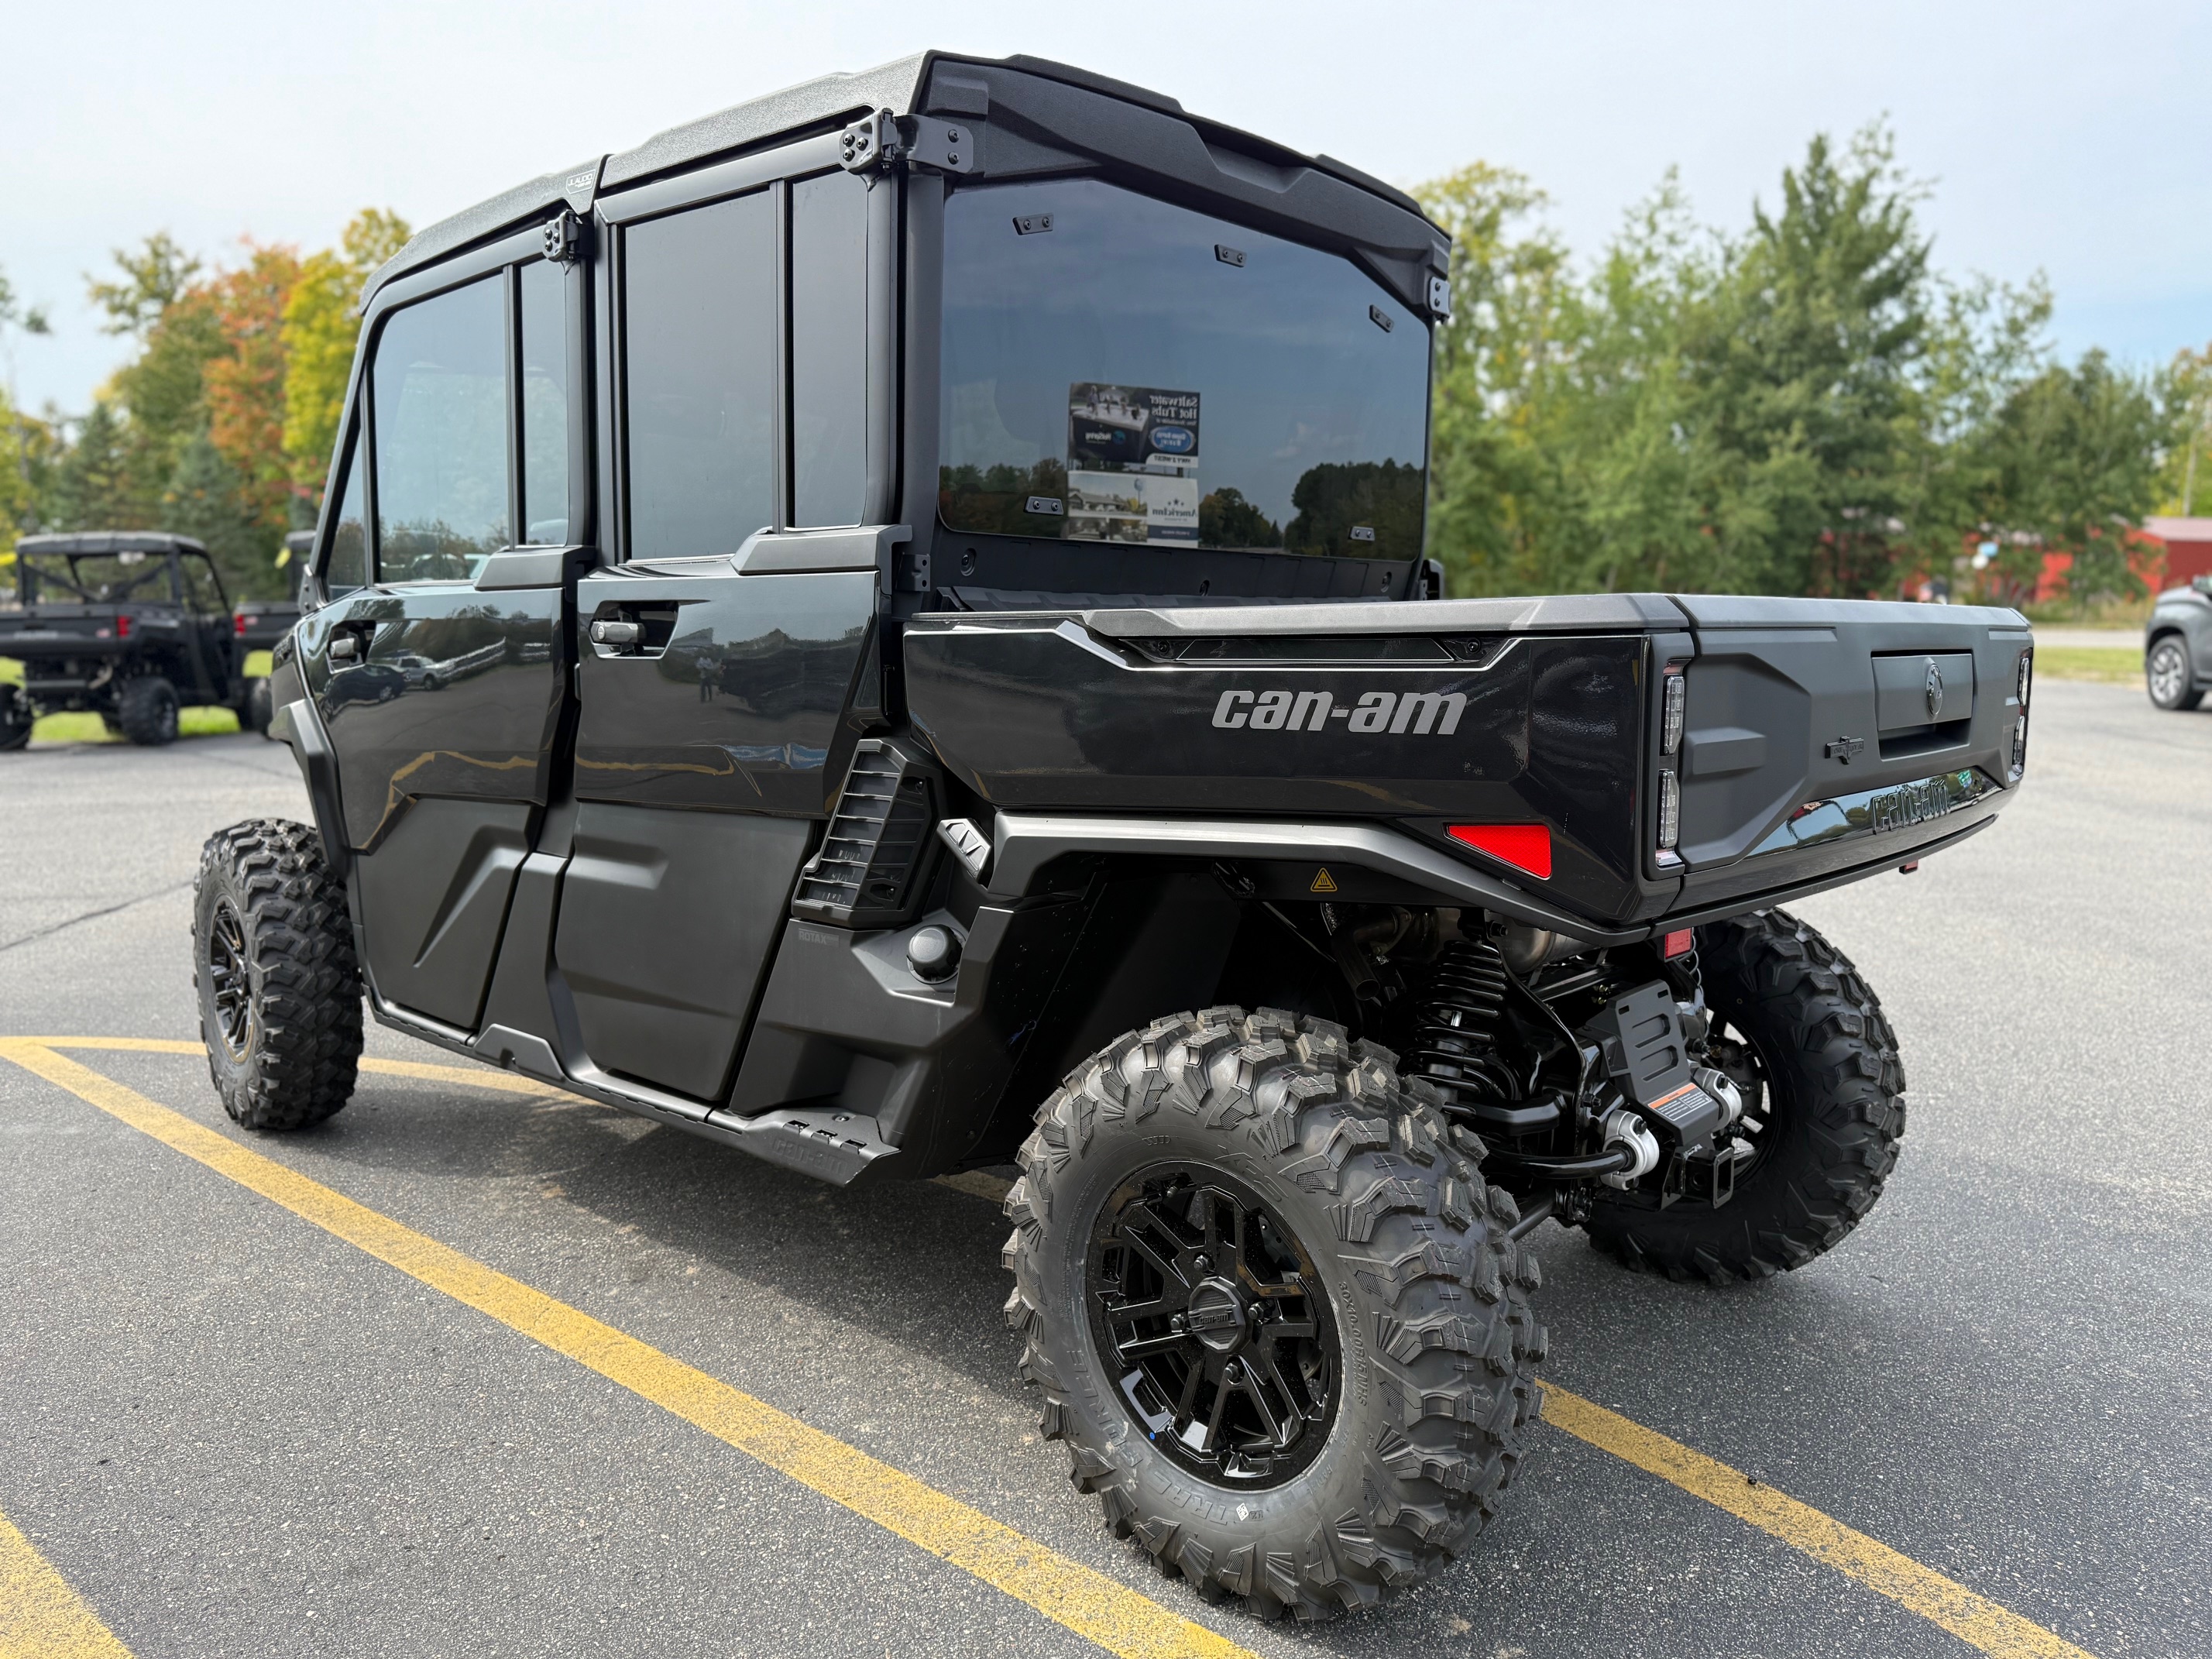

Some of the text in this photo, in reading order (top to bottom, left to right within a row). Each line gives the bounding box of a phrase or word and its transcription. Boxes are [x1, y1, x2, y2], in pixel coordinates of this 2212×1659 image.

[1211, 690, 1468, 735] can-am
[1870, 778, 1951, 835] can-am
[799, 930, 827, 945] ROTAX
[1198, 1313, 1229, 1324] can-am
